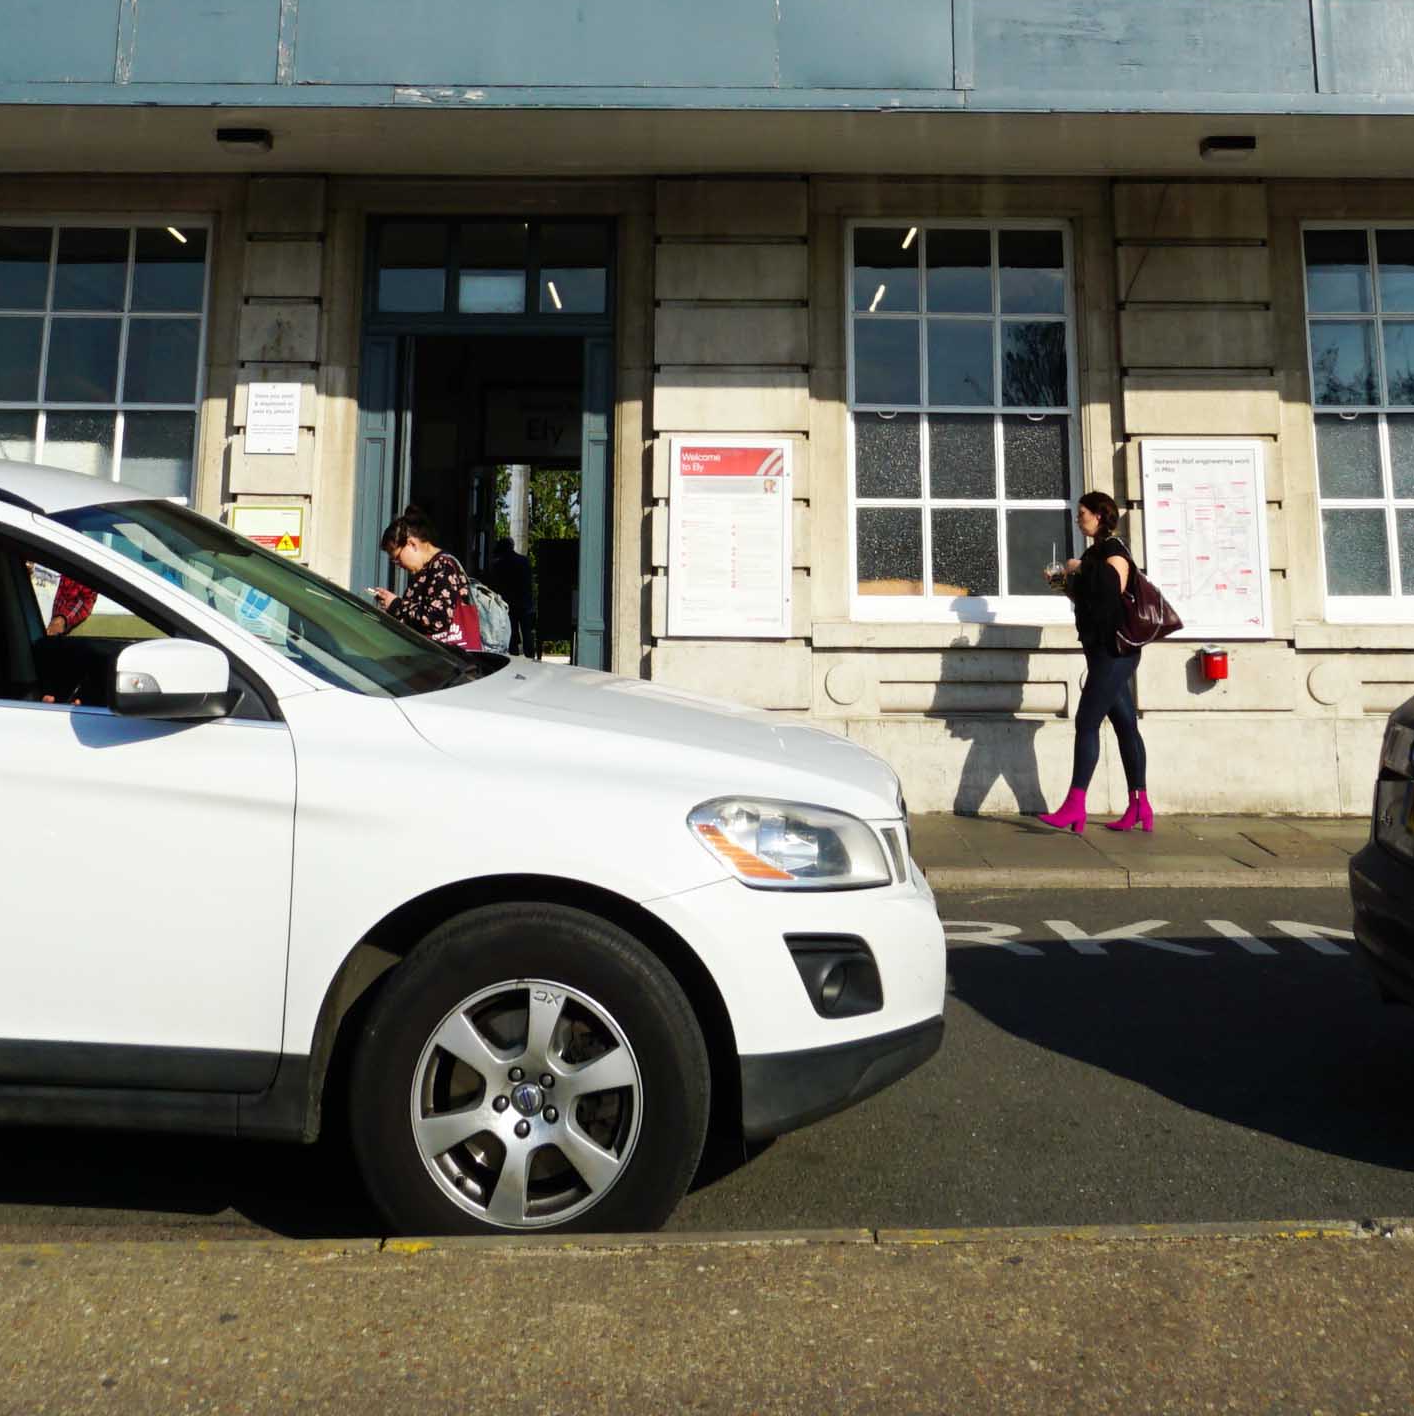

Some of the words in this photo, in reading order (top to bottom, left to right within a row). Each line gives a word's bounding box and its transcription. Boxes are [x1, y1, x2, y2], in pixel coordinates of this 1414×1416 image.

[681, 452, 721, 462] Welcome
[682, 463, 691, 471] to
[692, 463, 704, 472] Ely
